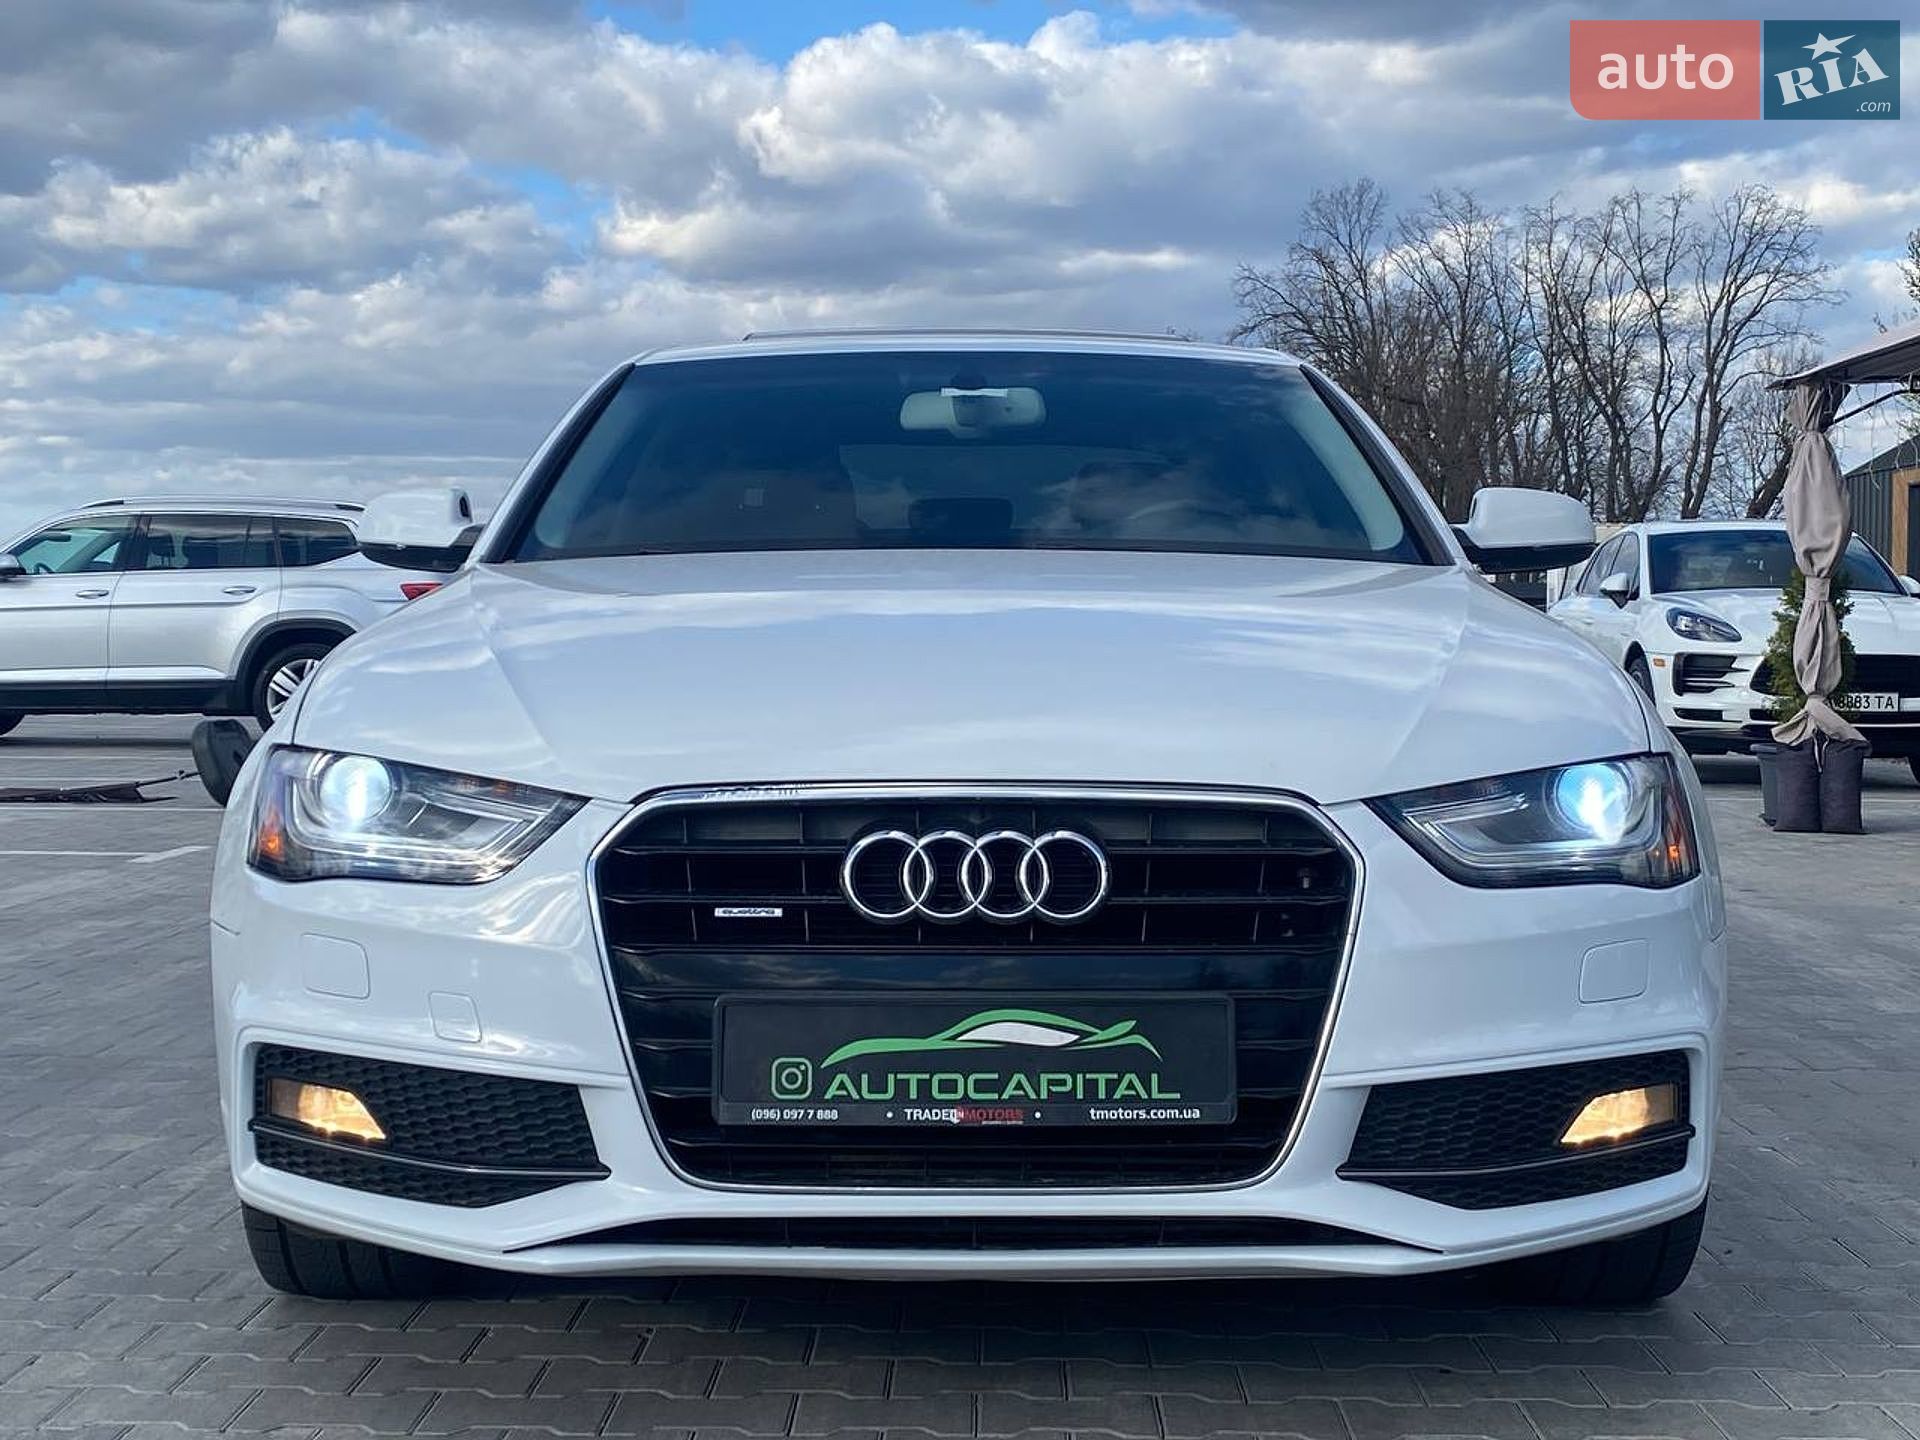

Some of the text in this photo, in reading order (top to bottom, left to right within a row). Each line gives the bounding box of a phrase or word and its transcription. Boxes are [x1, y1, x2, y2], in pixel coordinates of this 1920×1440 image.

[1874, 695, 1895, 709] TA
[824, 1073, 1181, 1099] AUTOCAPITAL
[751, 1108, 781, 1121] (096)
[1089, 1107, 1200, 1120] tmotors.com.ua
